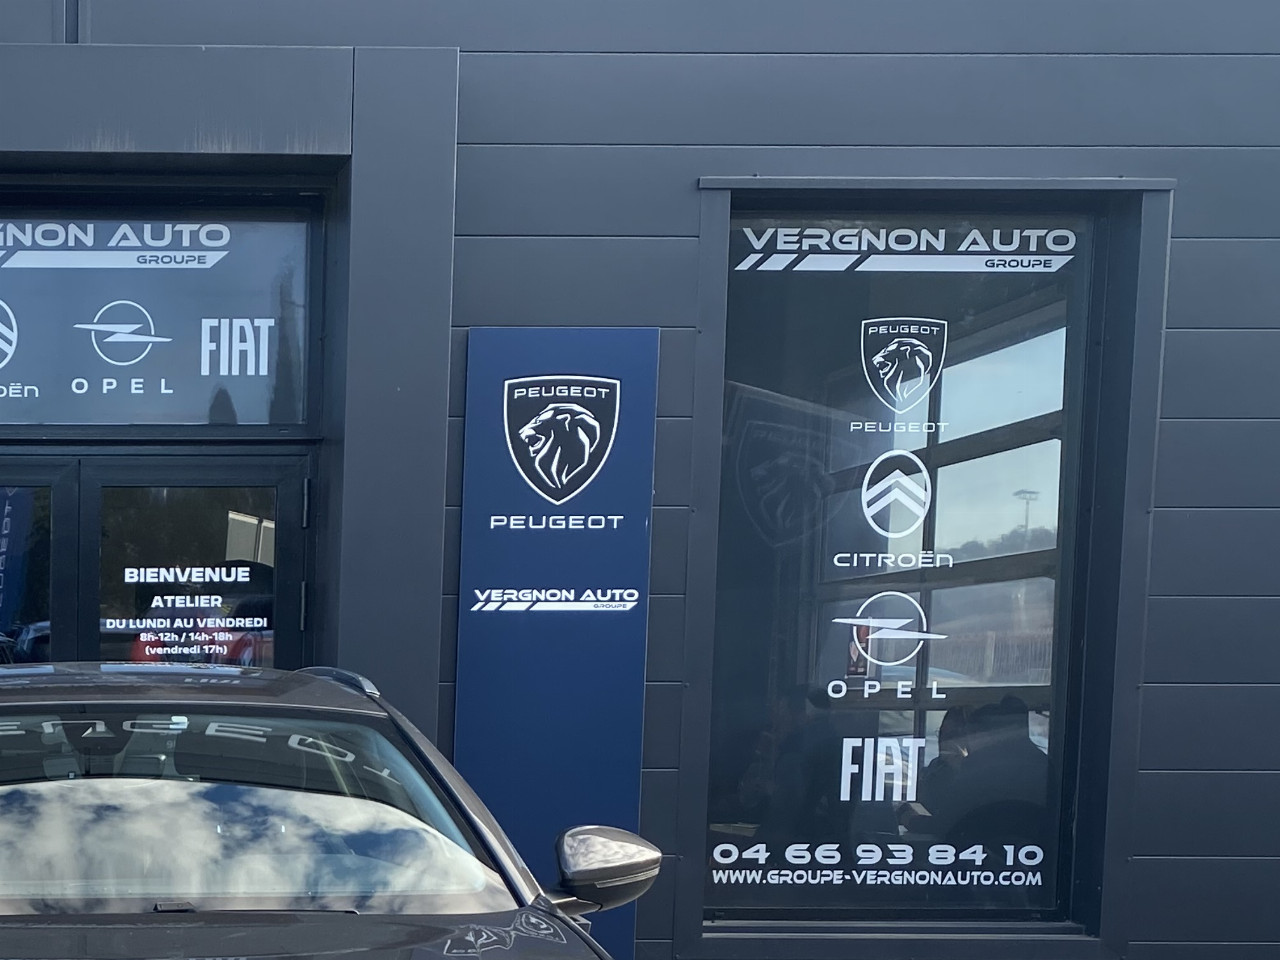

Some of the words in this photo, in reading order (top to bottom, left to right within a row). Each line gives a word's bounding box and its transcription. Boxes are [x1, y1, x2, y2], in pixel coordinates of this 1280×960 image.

[106, 223, 231, 248] AUTO
[742, 227, 946, 252] VERGNON
[957, 228, 1077, 252] AUTO
[136, 254, 207, 266] GROUPE
[984, 259, 1053, 269] GROUPE
[868, 325, 940, 335] PEUGEOT
[200, 318, 275, 376] FIAT
[71, 378, 174, 394] OPEL
[513, 385, 610, 399] PEUGEOT
[849, 421, 950, 433] PEUGEOT
[490, 515, 624, 529] PEUGEOT
[124, 566, 250, 583] BIENVENUE
[150, 595, 223, 608] ATELIER
[474, 589, 575, 601] VERGNON
[579, 588, 639, 601] AUTO
[105, 618, 126, 629] DU
[128, 618, 171, 629] LUNDI
[172, 617, 194, 629] AU
[196, 617, 268, 628] VENDREDI
[139, 631, 179, 642] 8h-12h
[180, 632, 187, 643] /
[188, 631, 234, 642] 14h-18h
[144, 644, 201, 656] (vendredi
[202, 644, 228, 656] 17h)
[827, 680, 947, 699] OPEL
[840, 737, 926, 802] FIAT
[712, 843, 771, 865] 04
[784, 843, 842, 865] 66
[855, 843, 914, 865] 93
[928, 844, 988, 866] 84
[1002, 844, 1044, 866] 10
[712, 869, 1042, 886] WWW.GROUPE-VERGNONAUTO.COM
